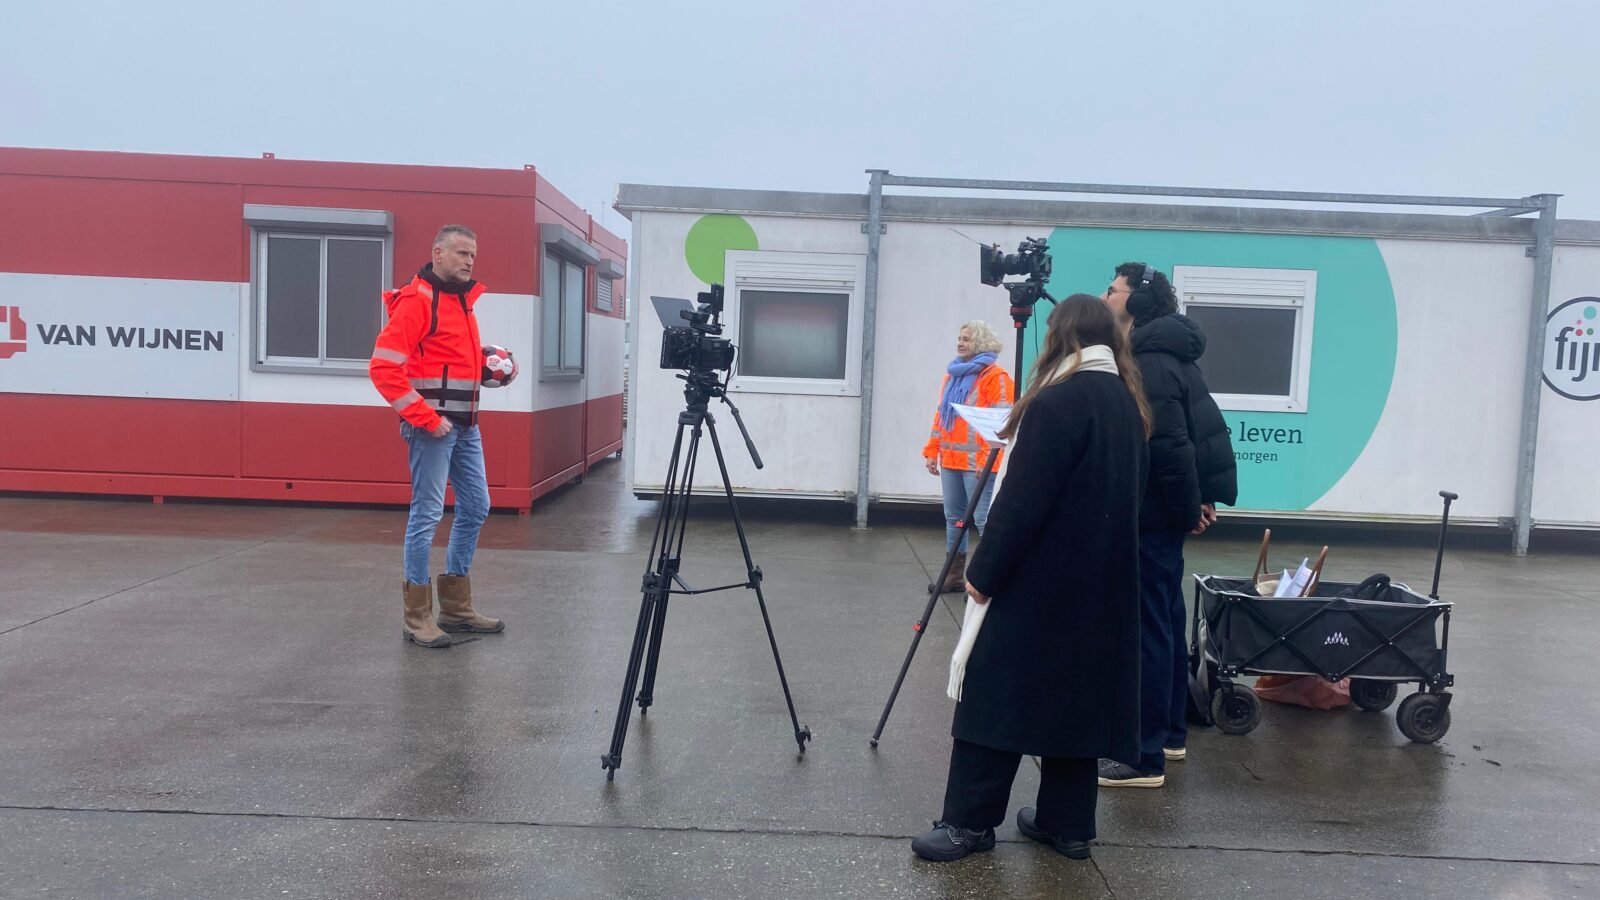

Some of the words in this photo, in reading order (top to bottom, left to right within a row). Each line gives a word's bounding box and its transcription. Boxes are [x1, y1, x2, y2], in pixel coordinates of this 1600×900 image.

[36, 323, 96, 346] VAN
[106, 326, 224, 351] WIJNEN
[1238, 421, 1303, 444] leven
